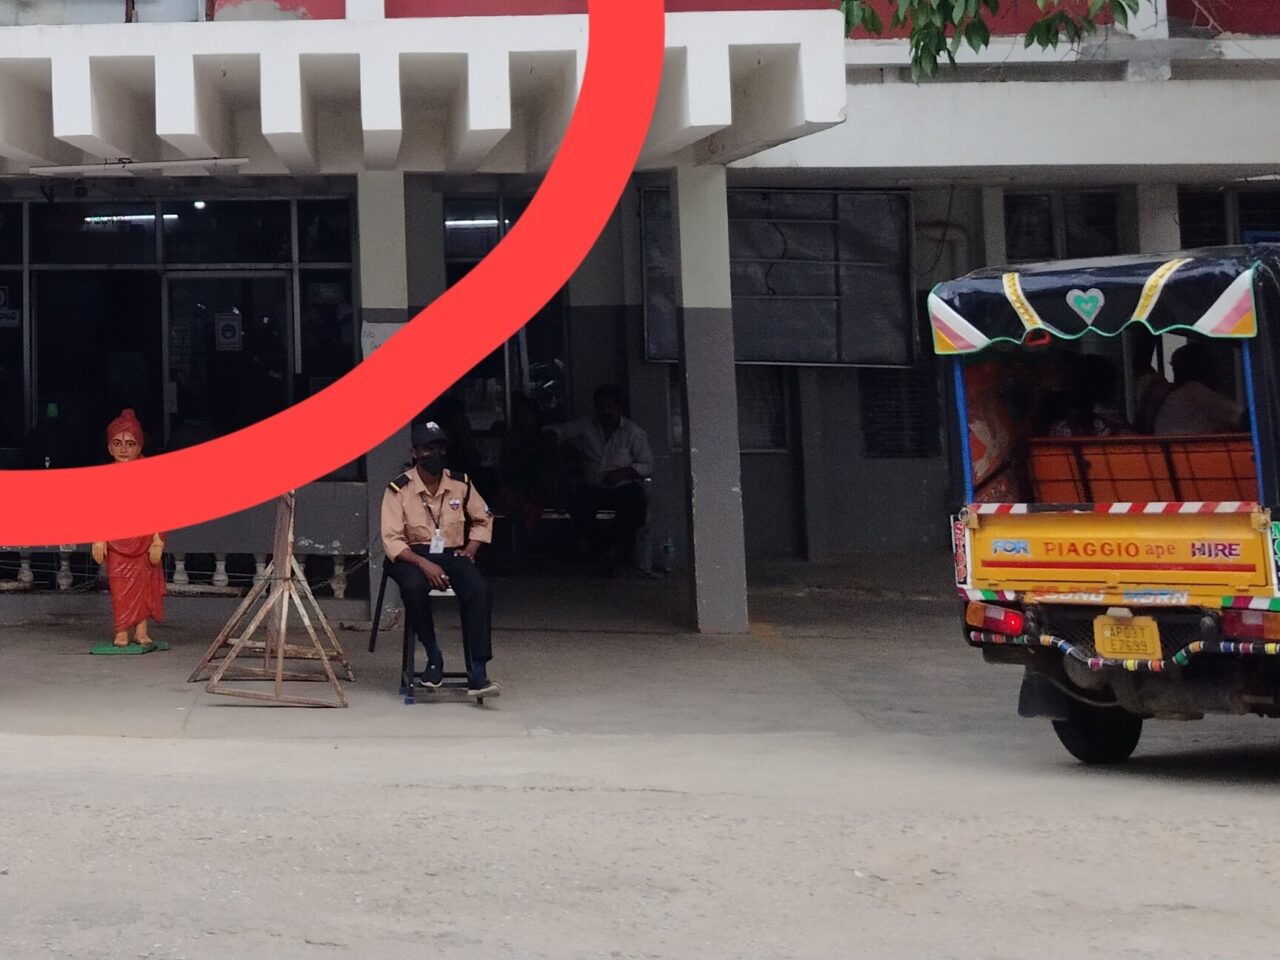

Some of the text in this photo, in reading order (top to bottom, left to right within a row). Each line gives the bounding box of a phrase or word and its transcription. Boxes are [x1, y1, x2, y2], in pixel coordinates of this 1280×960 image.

[953, 520, 967, 582] STOP
[992, 539, 1031, 557] FOR
[1043, 542, 1176, 559] PIAGGIO ape
[1190, 542, 1241, 559] HIRE
